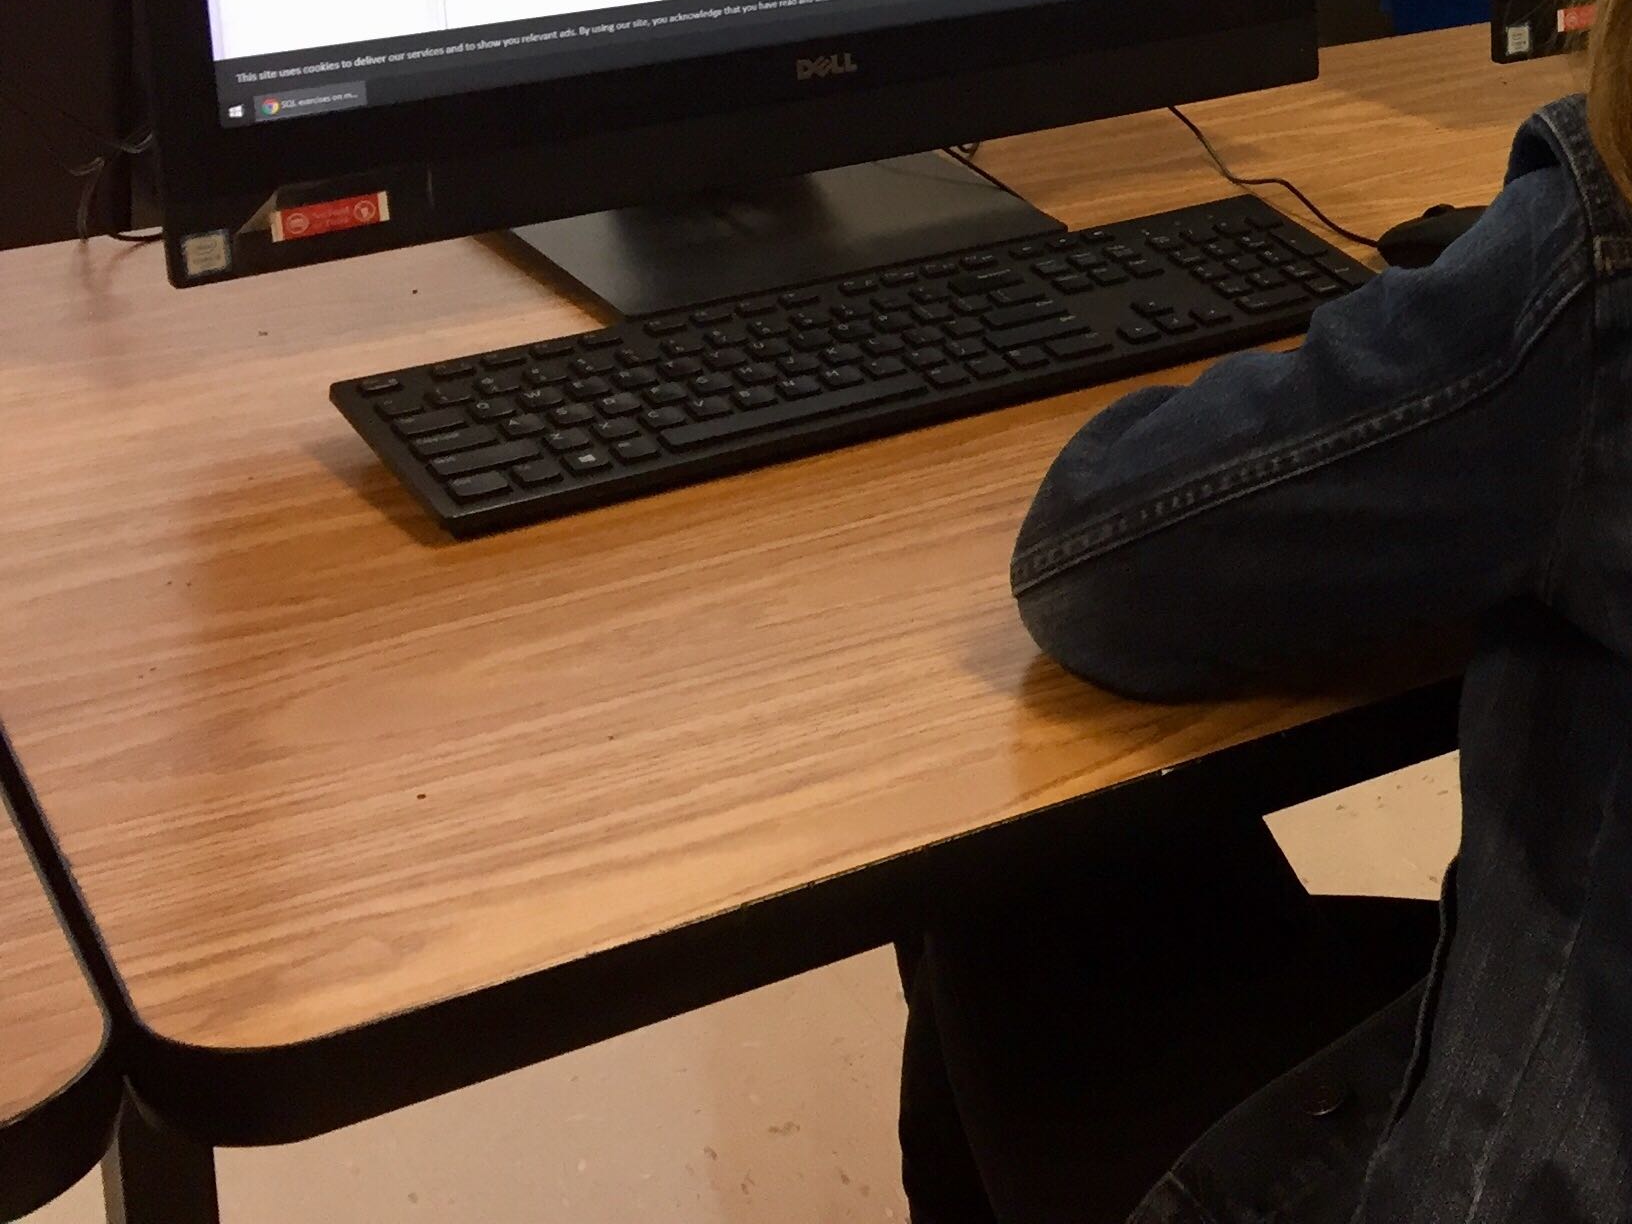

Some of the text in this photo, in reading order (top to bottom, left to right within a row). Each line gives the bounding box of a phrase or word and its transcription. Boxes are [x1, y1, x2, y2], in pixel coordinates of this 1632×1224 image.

[236, 72, 257, 83] This
[259, 70, 277, 80] site
[279, 67, 301, 78] uses
[303, 62, 339, 74] cookies
[341, 60, 352, 68] to
[354, 54, 386, 67] deliver
[388, 52, 405, 62] our
[407, 46, 444, 59] services
[446, 43, 463, 54] and
[465, 42, 476, 51] to
[477, 37, 501, 49] show
[503, 36, 520, 47] you
[521, 30, 557, 43] relevant
[579, 26, 590, 36] By
[591, 23, 614, 34] using
[616, 21, 630, 30] our
[651, 17, 668, 26] you
[669, 9, 722, 23] acknowledge
[724, 6, 740, 15] that
[742, 3, 757, 13] you
[758, 0, 778, 10] have
[797, 53, 858, 80] DELL
